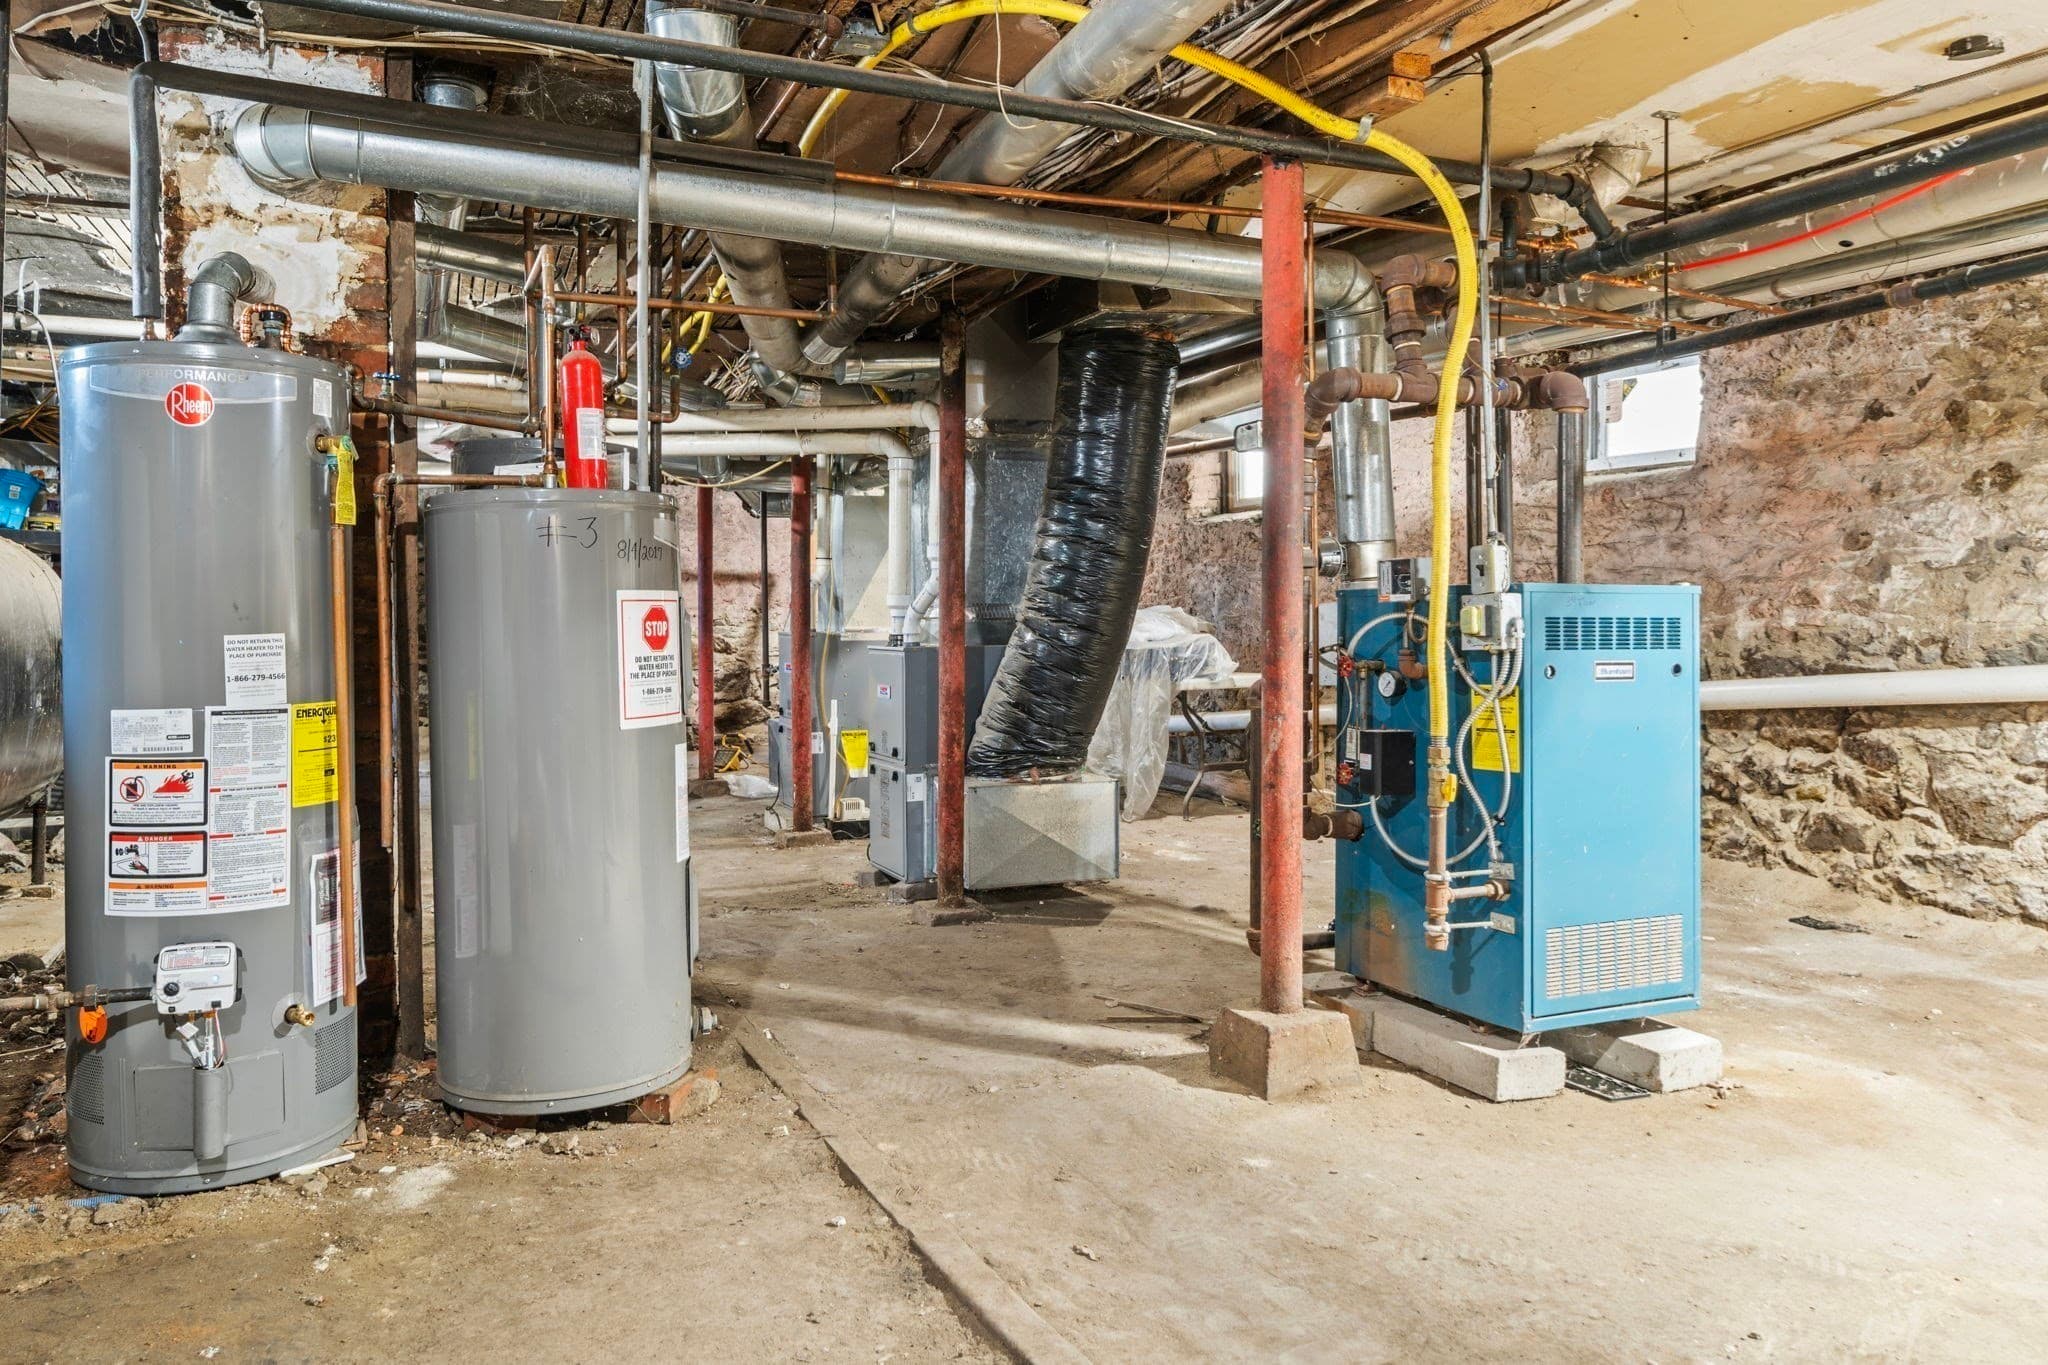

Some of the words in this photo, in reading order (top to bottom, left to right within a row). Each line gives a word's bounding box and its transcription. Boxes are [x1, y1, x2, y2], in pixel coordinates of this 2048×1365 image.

[138, 368, 246, 383] PERFORMANCE
[171, 384, 211, 419] Rheem
[645, 621, 668, 637] STOP
[641, 671, 655, 679] PLACE
